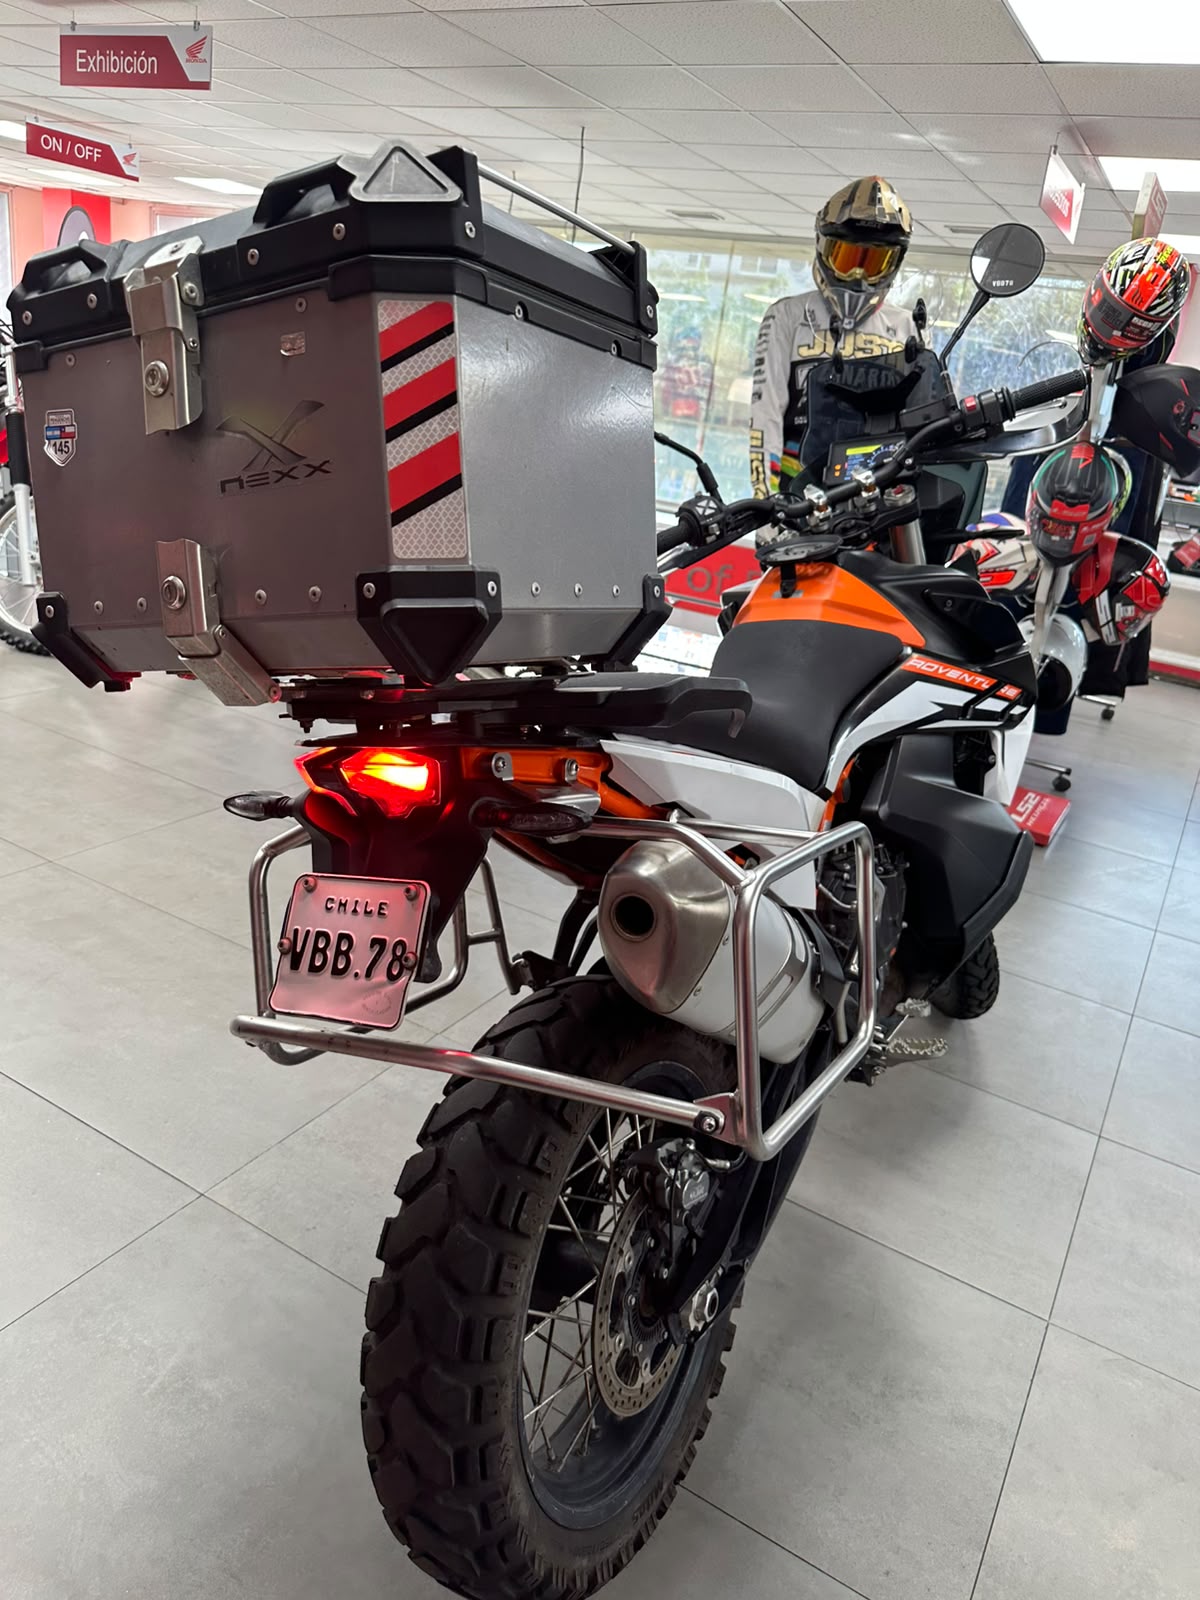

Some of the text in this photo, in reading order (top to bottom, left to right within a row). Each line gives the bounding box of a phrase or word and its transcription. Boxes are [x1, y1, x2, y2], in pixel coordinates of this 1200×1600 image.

[76, 49, 158, 75] Exhibición
[40, 134, 102, 163] ON / OFF
[52, 441, 70, 455] 145
[1010, 791, 1041, 823] LS2
[324, 896, 390, 918] CHILE
